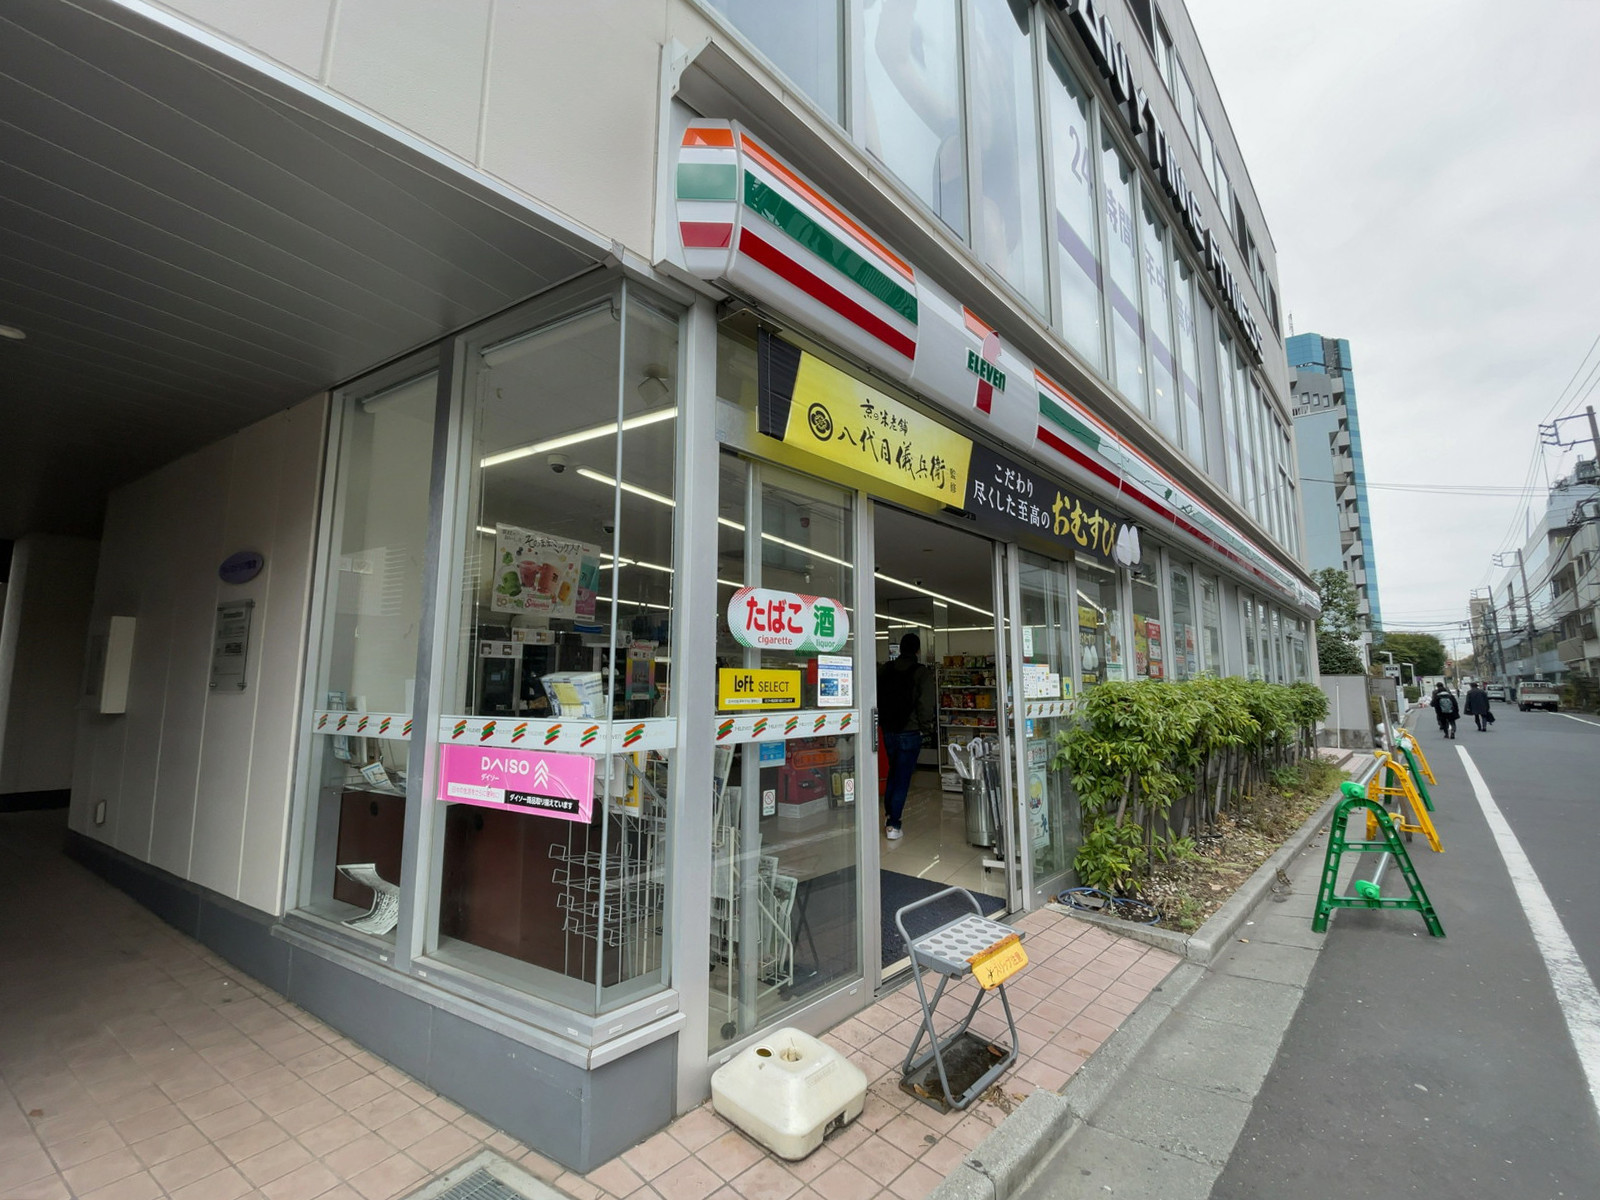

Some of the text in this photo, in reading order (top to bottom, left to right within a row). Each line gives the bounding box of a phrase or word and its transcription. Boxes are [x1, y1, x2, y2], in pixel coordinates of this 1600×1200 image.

[1203, 228, 1263, 365] FITNESS
[837, 426, 946, 490] 八代目儀兵衛
[994, 463, 1034, 498] こだわり
[973, 479, 1050, 529] 尽くした至高の
[1052, 490, 1117, 557] おむすび
[746, 595, 835, 637] たばこ 酒
[757, 635, 836, 649] cigarette liquor
[758, 681, 790, 693] SELECT
[480, 773, 500, 782] ダイソー
[481, 756, 530, 775] DAISO
